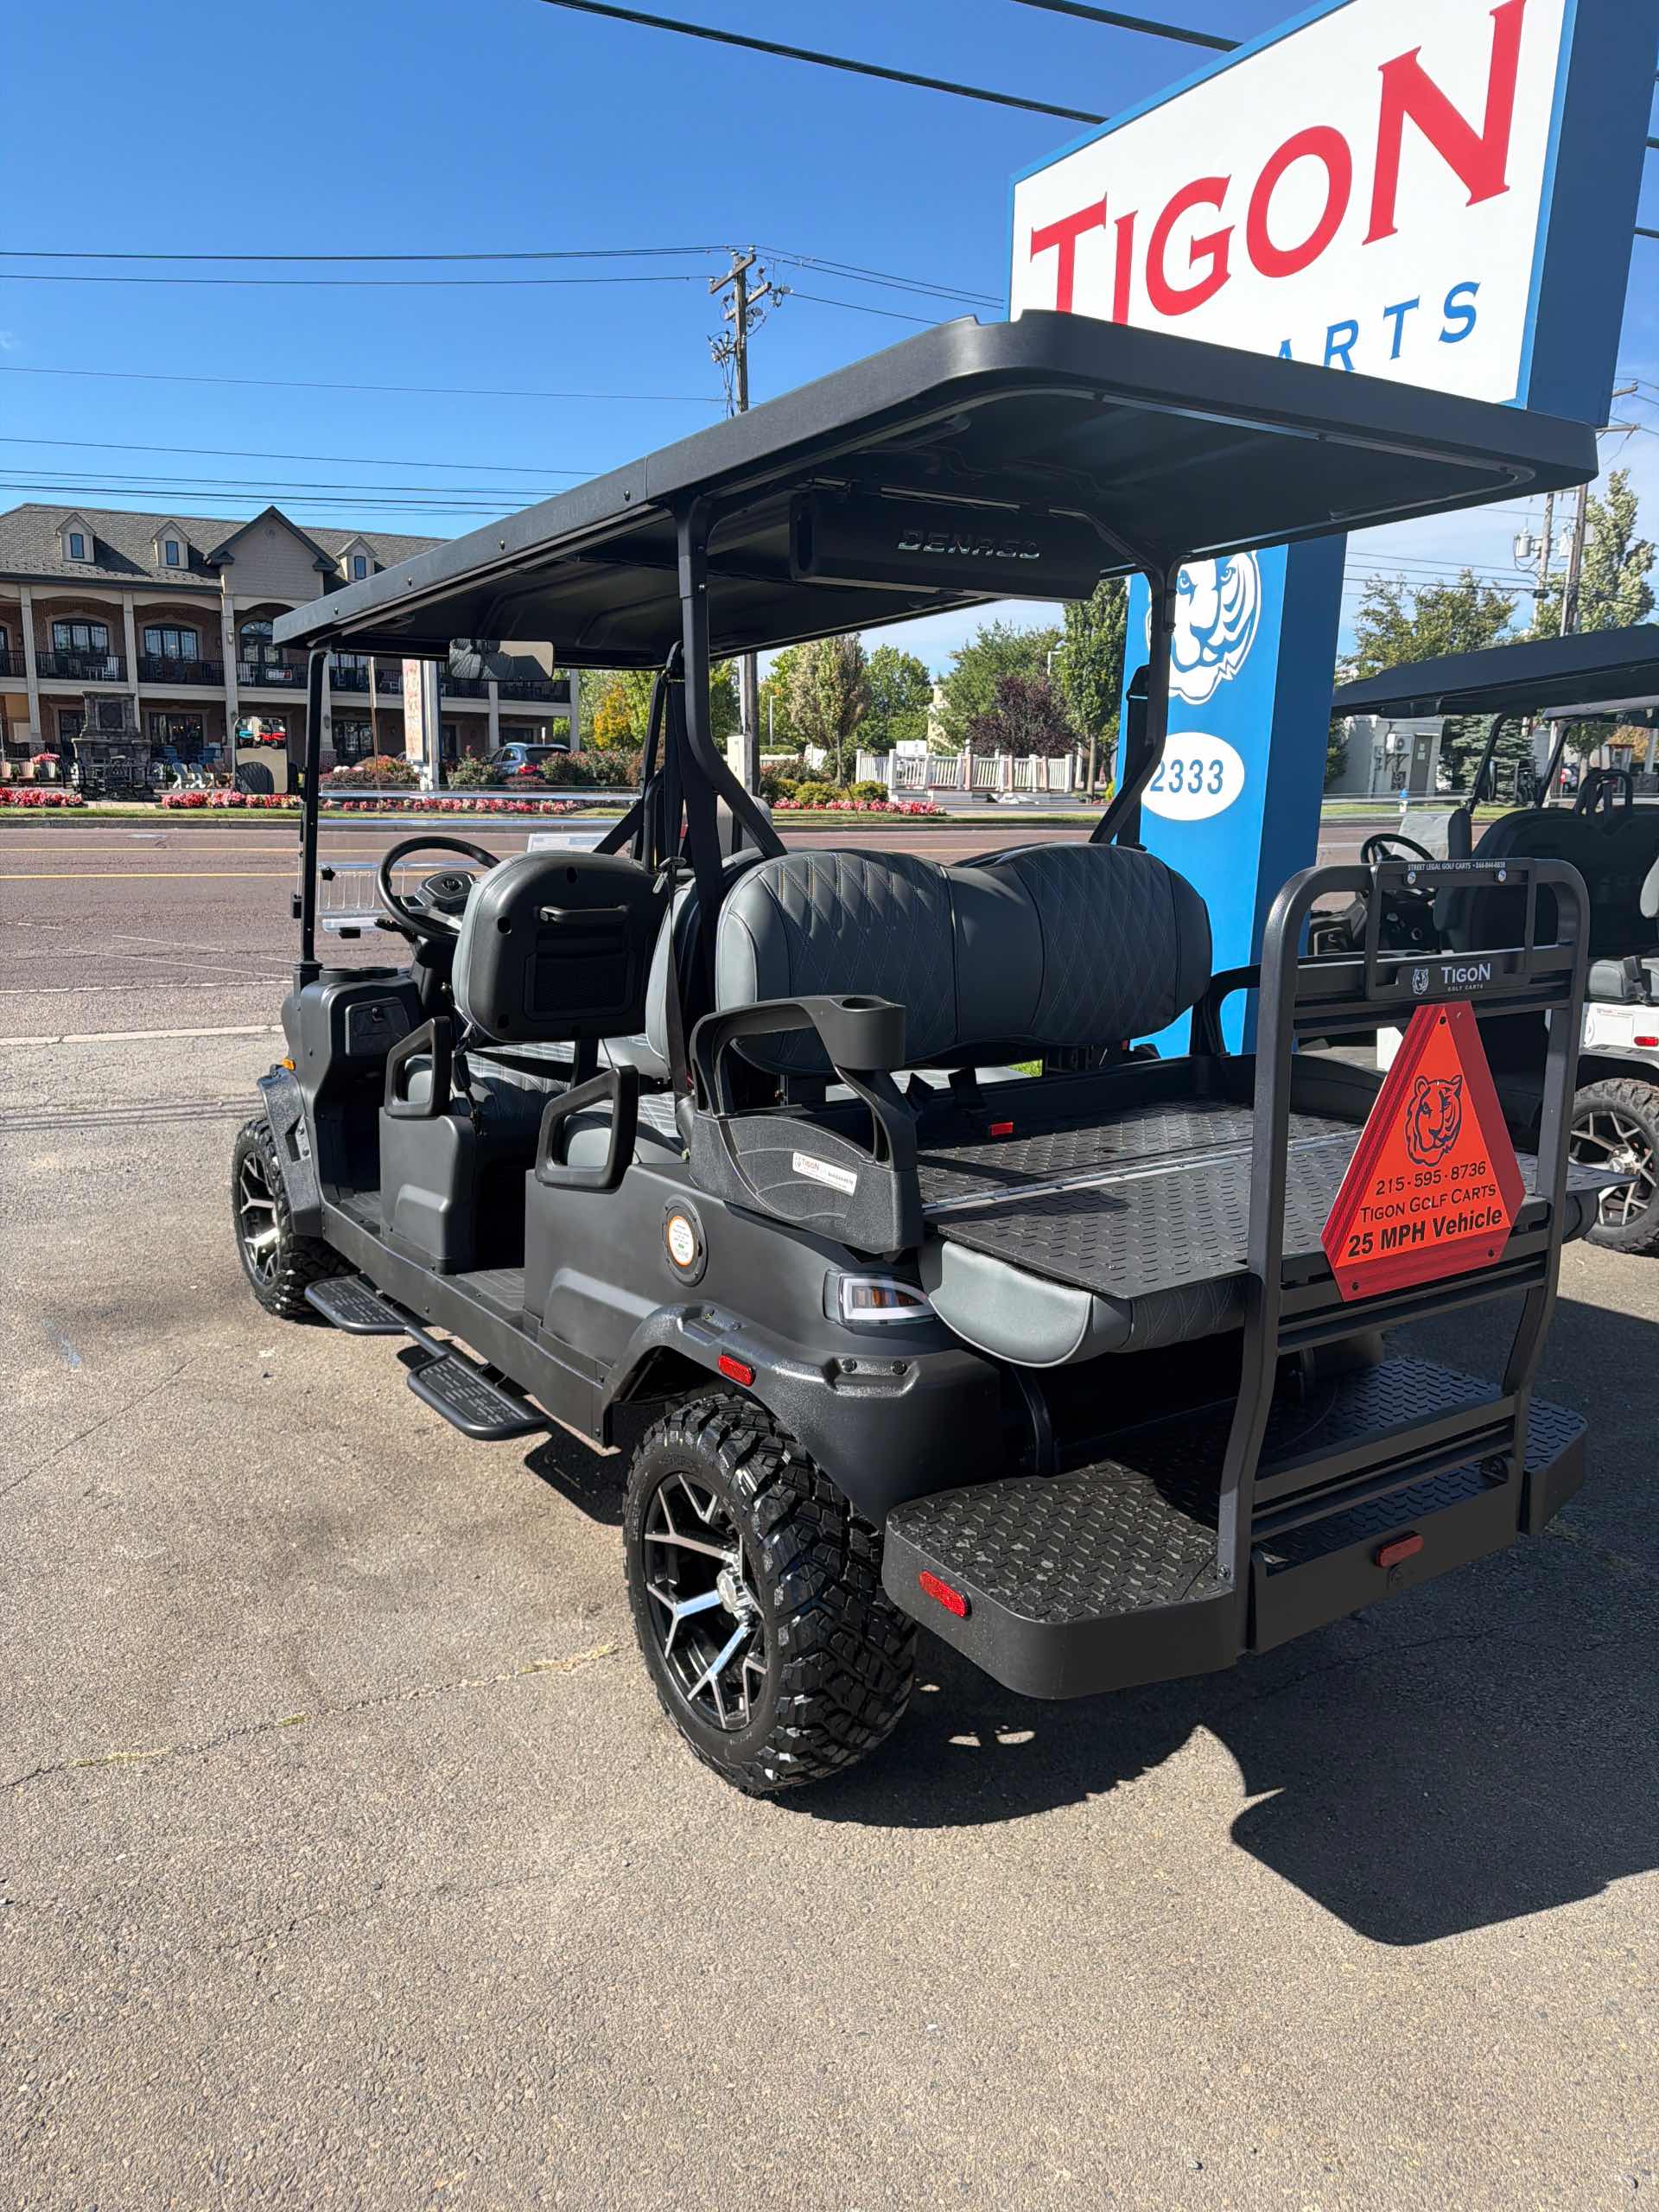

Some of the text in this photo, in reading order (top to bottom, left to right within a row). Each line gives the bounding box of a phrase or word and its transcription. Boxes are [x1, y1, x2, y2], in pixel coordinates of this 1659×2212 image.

[1030, 0, 1526, 325] TIGON
[1149, 759, 1224, 794] 2333
[1440, 963, 1491, 983] TIGON
[1360, 1184, 1497, 1224] TIGON GOLF CARTS
[1347, 1206, 1503, 1258] 25 MPH Vehicle
